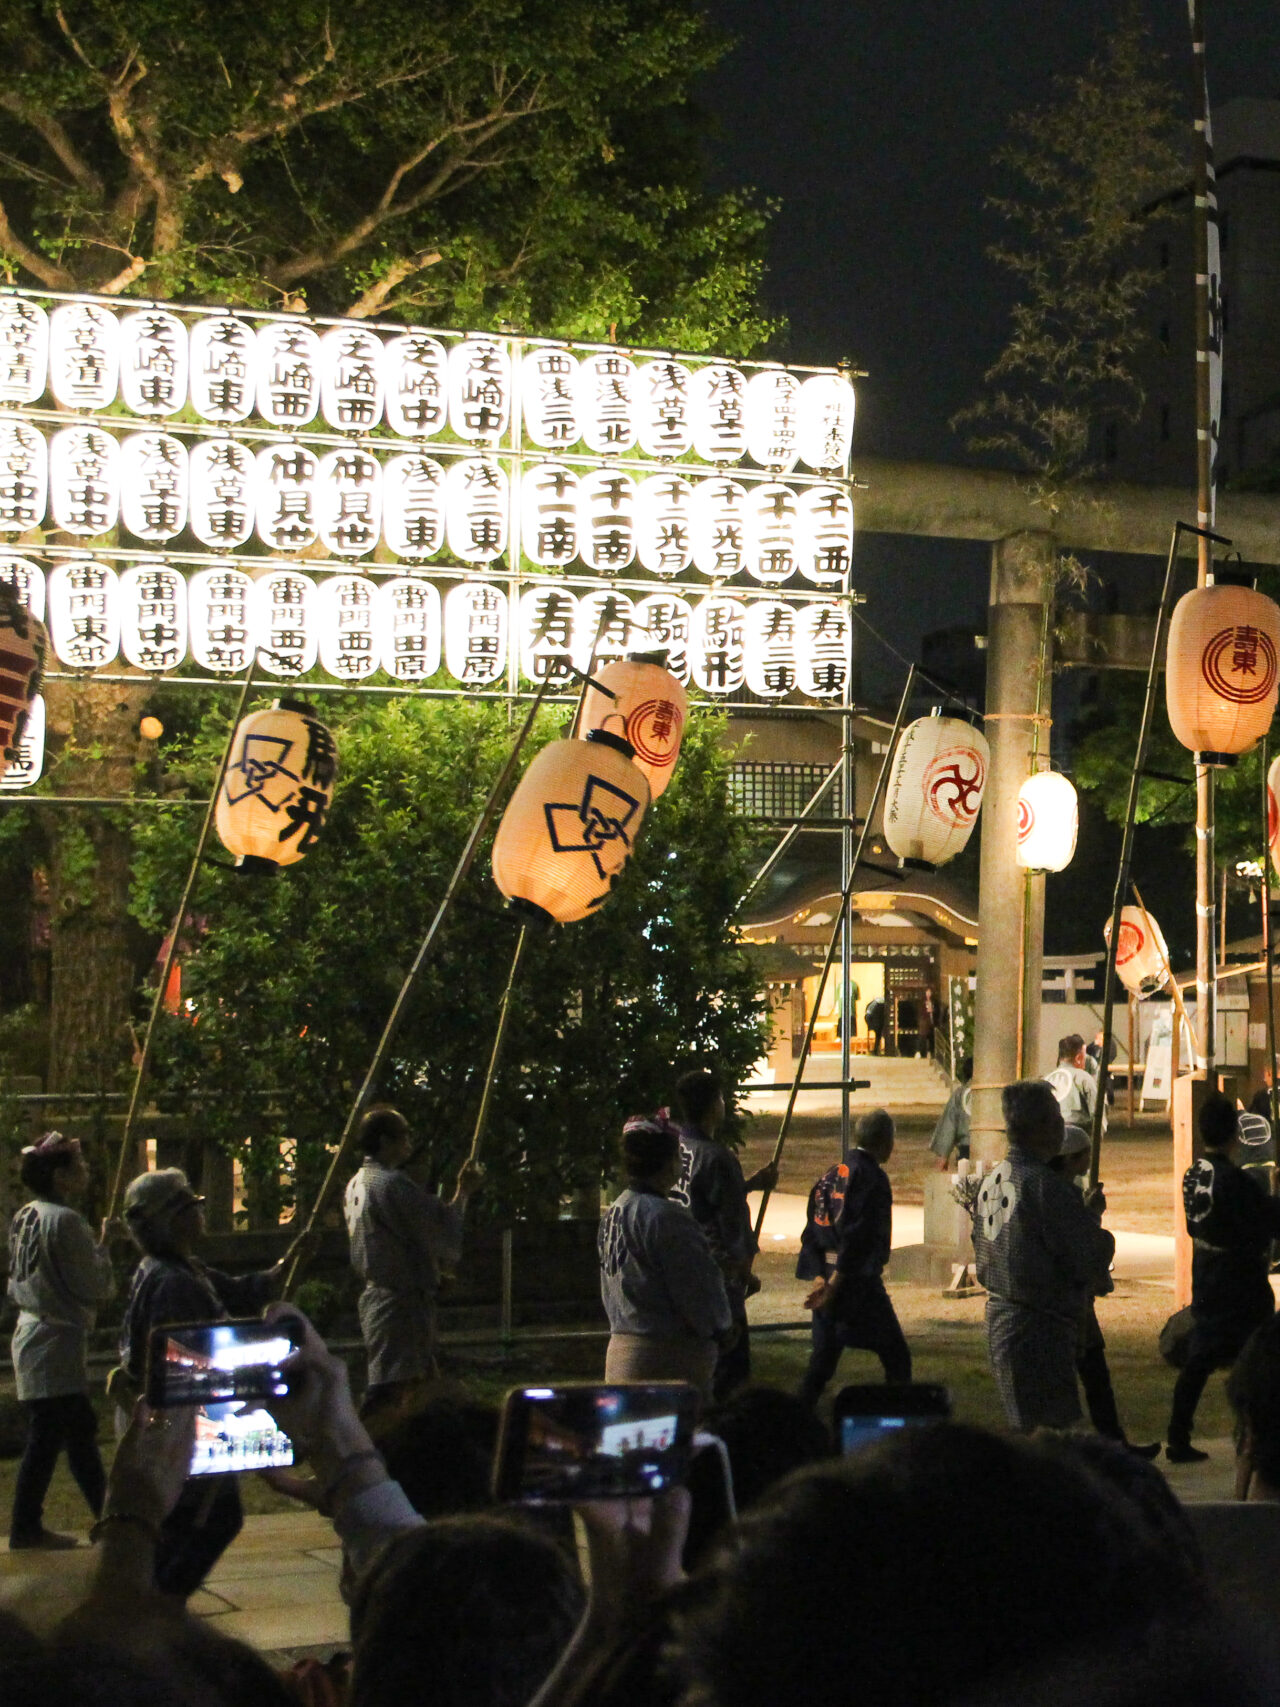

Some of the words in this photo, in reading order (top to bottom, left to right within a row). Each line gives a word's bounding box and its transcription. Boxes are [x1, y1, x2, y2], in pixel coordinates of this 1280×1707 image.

[134, 316, 177, 408] 芝崎東
[203, 322, 246, 414] 芝崎東
[269, 329, 312, 417] 芝崎西
[335, 334, 378, 424] 芝崎西
[399, 339, 440, 429] 芝崎中
[462, 346, 503, 434] 芝崎中
[537, 356, 575, 440] 西浅三北
[595, 358, 631, 444] 西浅三北
[649, 364, 689, 450] 浅草二
[708, 365, 744, 453] 浅草二
[66, 432, 110, 531] 浅草中央
[139, 438, 181, 533] 浅草東
[205, 444, 246, 541] 浅草東
[269, 451, 315, 547] 仲見世
[329, 455, 374, 550] 仲見世
[400, 459, 440, 551] 浅三東
[464, 464, 503, 553] 浅三東
[536, 471, 578, 559] 千一南
[590, 477, 633, 564] 千一南
[758, 491, 797, 574] 千二西
[809, 492, 850, 574] 千二西
[66, 566, 110, 662] 雷門東部
[136, 571, 180, 666] 雷門中部
[206, 573, 248, 667] 雷門中部
[336, 581, 374, 674] 雷門西部
[393, 585, 428, 675] 雷門田原
[462, 588, 501, 678] 雷門田原
[529, 592, 577, 679] 寿四
[702, 605, 747, 688] 駒形
[761, 607, 797, 692] 寿三東
[809, 608, 848, 692] 寿三東
